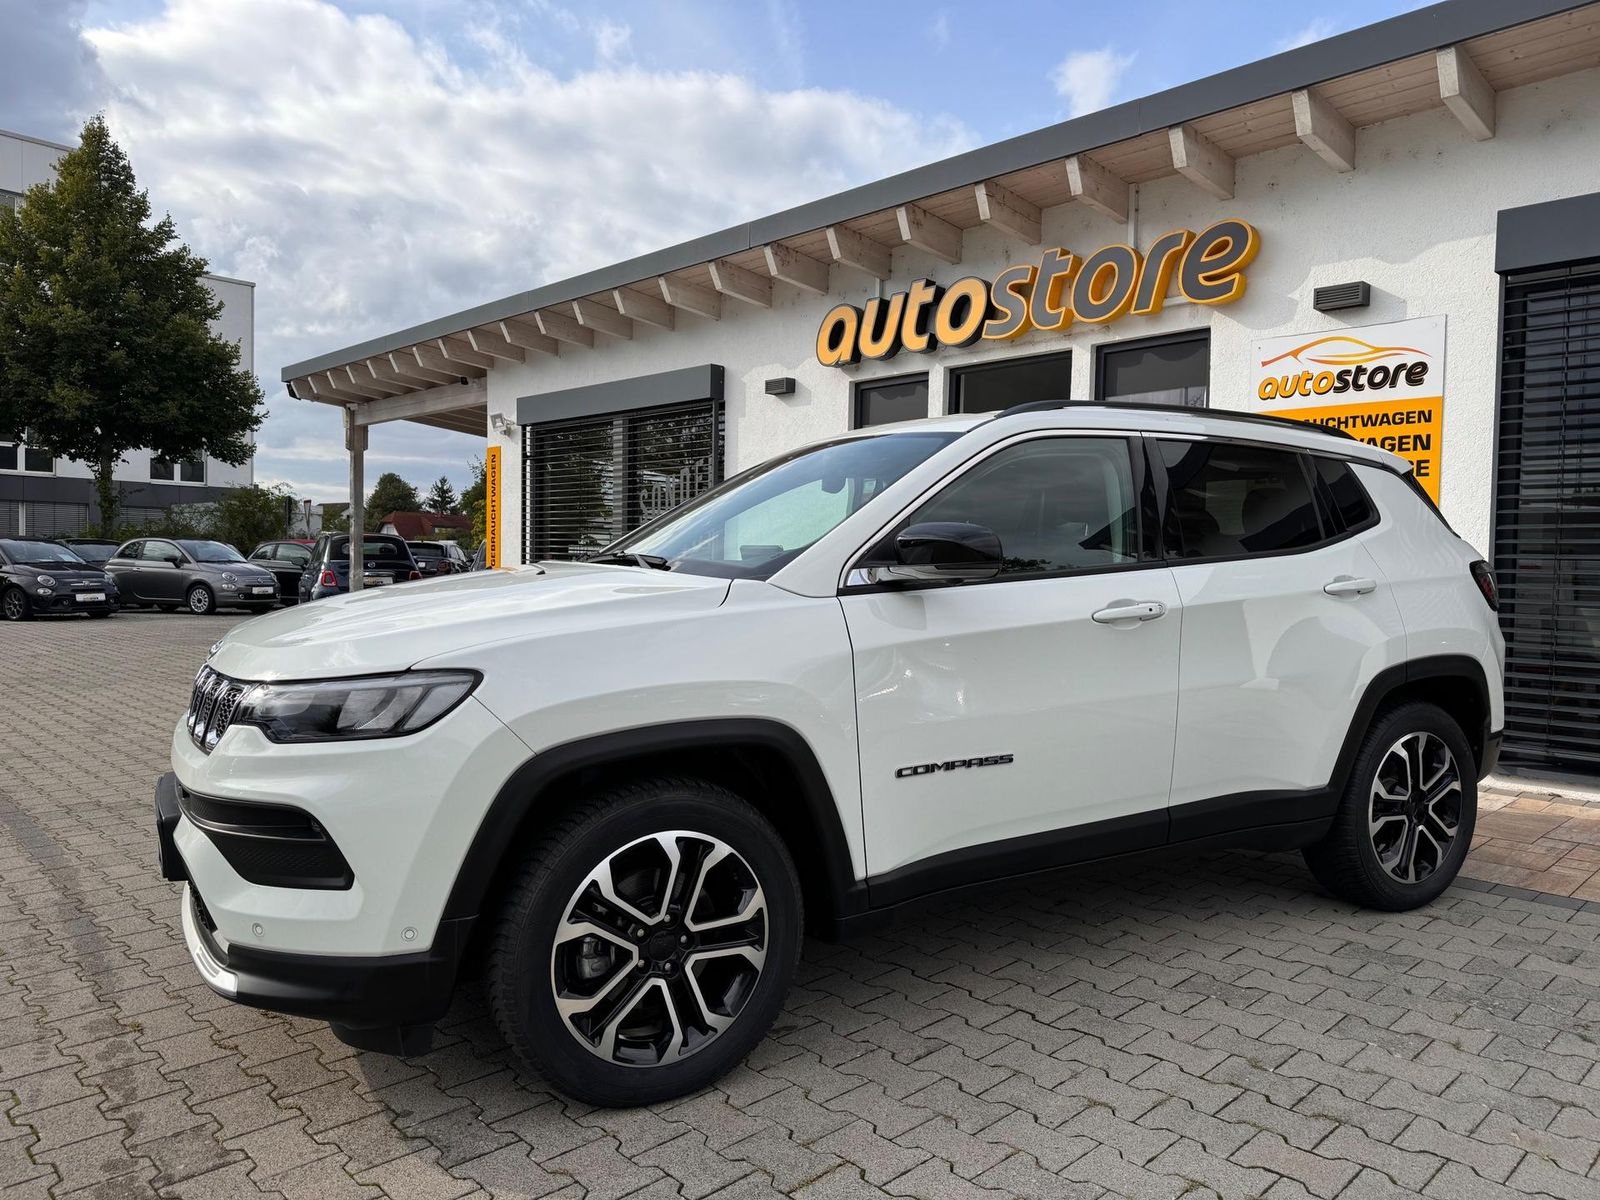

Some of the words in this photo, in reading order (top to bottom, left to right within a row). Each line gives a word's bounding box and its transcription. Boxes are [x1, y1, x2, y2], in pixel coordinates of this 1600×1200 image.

[816, 218, 1260, 367] autostore
[1258, 361, 1429, 400] autostore
[1304, 410, 1432, 429] CHTWAGEN
[1360, 434, 1431, 452] AGEN
[895, 754, 1014, 778] COMPASS
